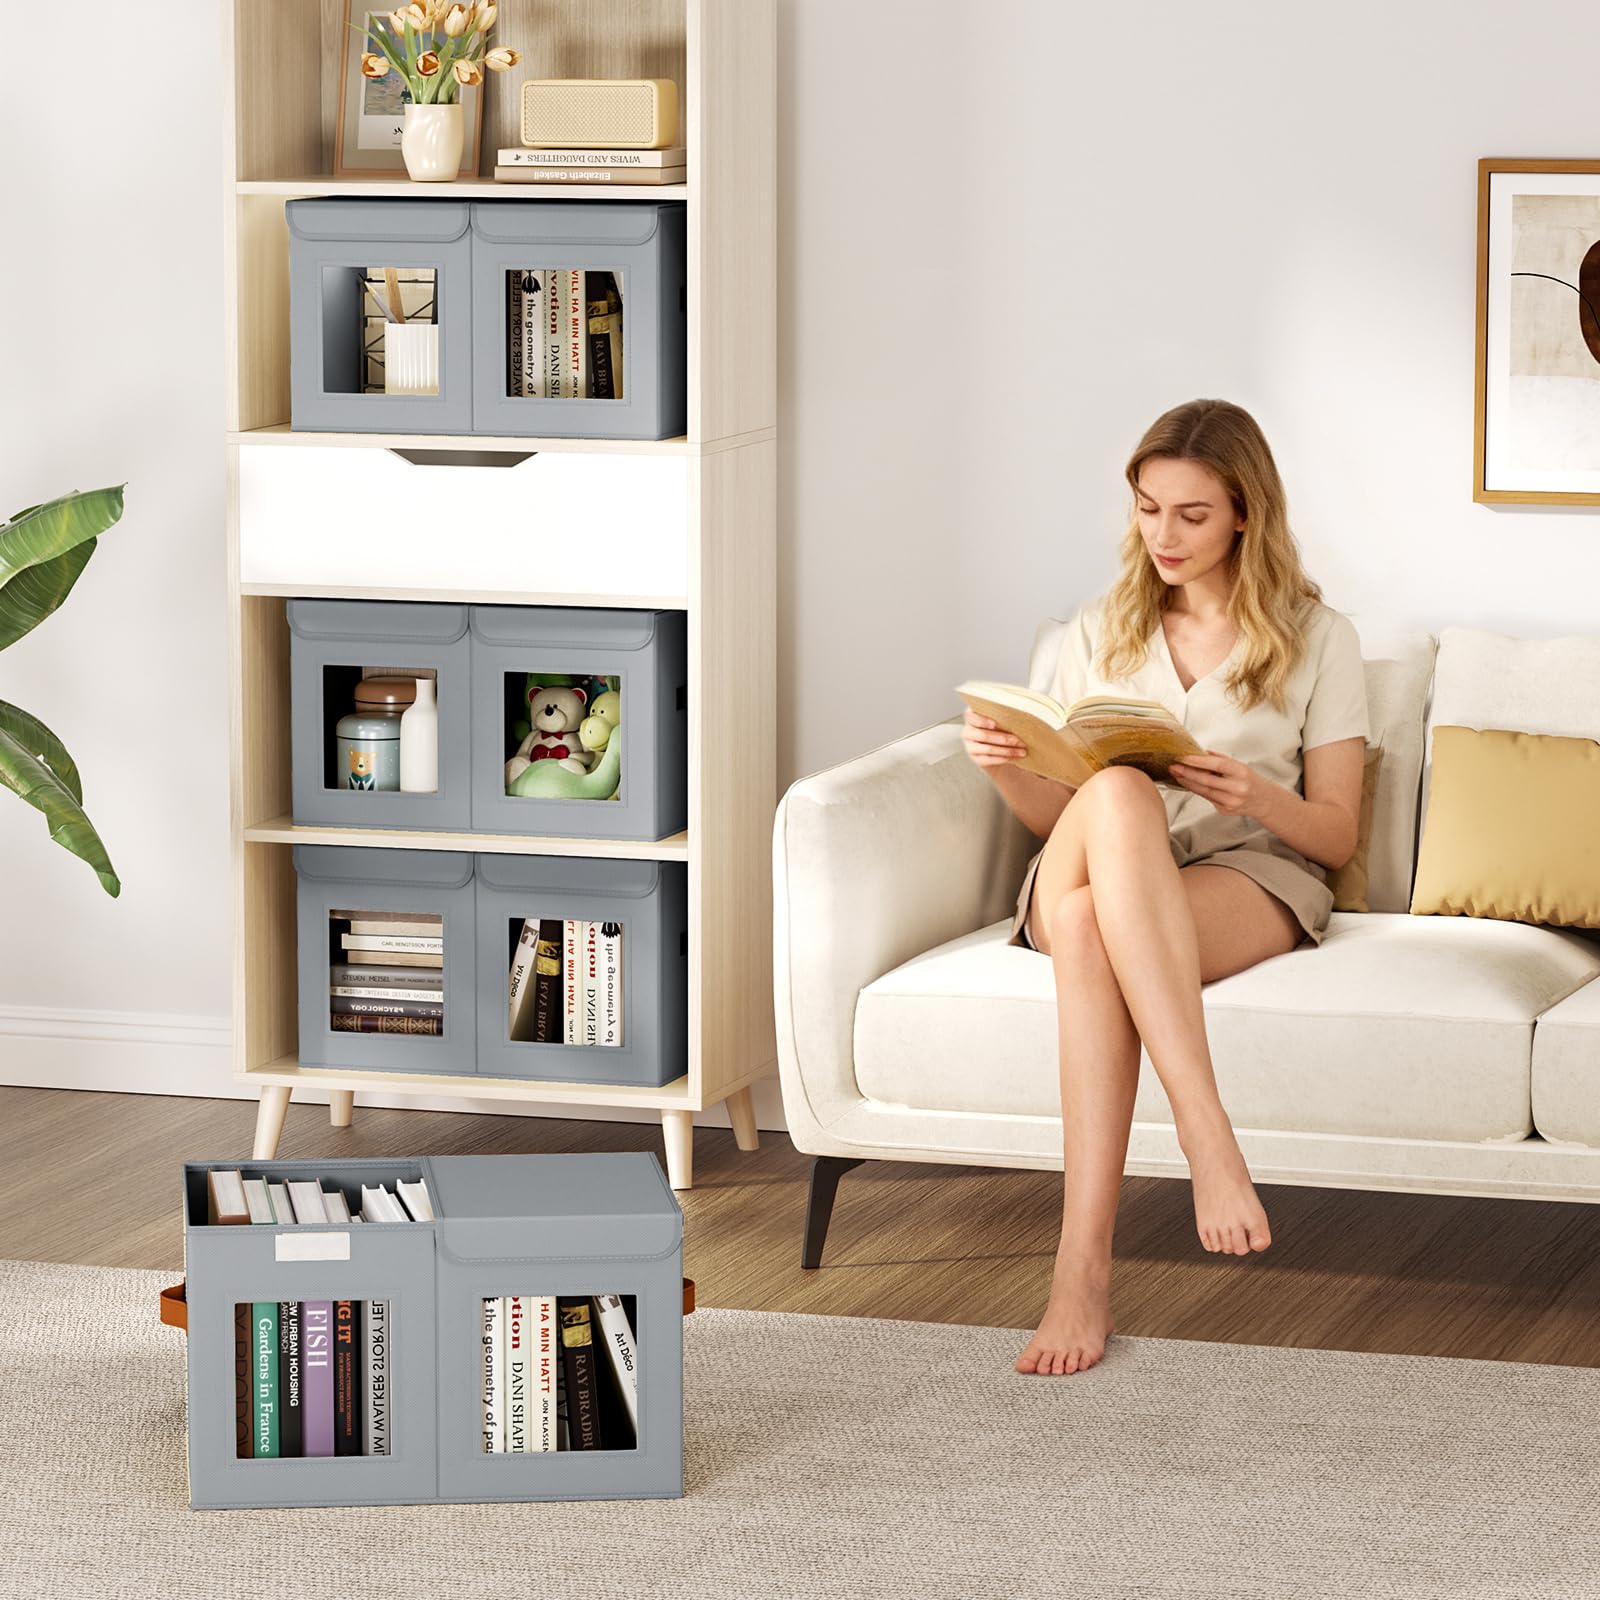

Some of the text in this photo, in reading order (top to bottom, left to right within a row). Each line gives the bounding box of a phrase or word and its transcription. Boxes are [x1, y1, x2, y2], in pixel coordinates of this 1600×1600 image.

[527, 154, 641, 164] WIVES AND DAUGHTERS
[534, 171, 611, 180] Elizabeth Gaskell
[572, 298, 579, 314] HA
[525, 299, 536, 395] the geometry of
[551, 345, 560, 377] DANI
[595, 340, 606, 365] RAY
[338, 1325, 351, 1344] IT
[485, 1309, 497, 1332] the
[289, 1320, 298, 1356] URBAN
[306, 1309, 328, 1368] FISH
[541, 1303, 550, 1393] HA MIN HATT
[614, 1332, 634, 1372] Art Déco
[258, 1318, 273, 1453] Gardens in France
[290, 1358, 298, 1407] HOUSING
[482, 1336, 494, 1408] geometry
[512, 1362, 523, 1400] DANI
[575, 1354, 589, 1385] RAY
[485, 1412, 497, 1427] of
